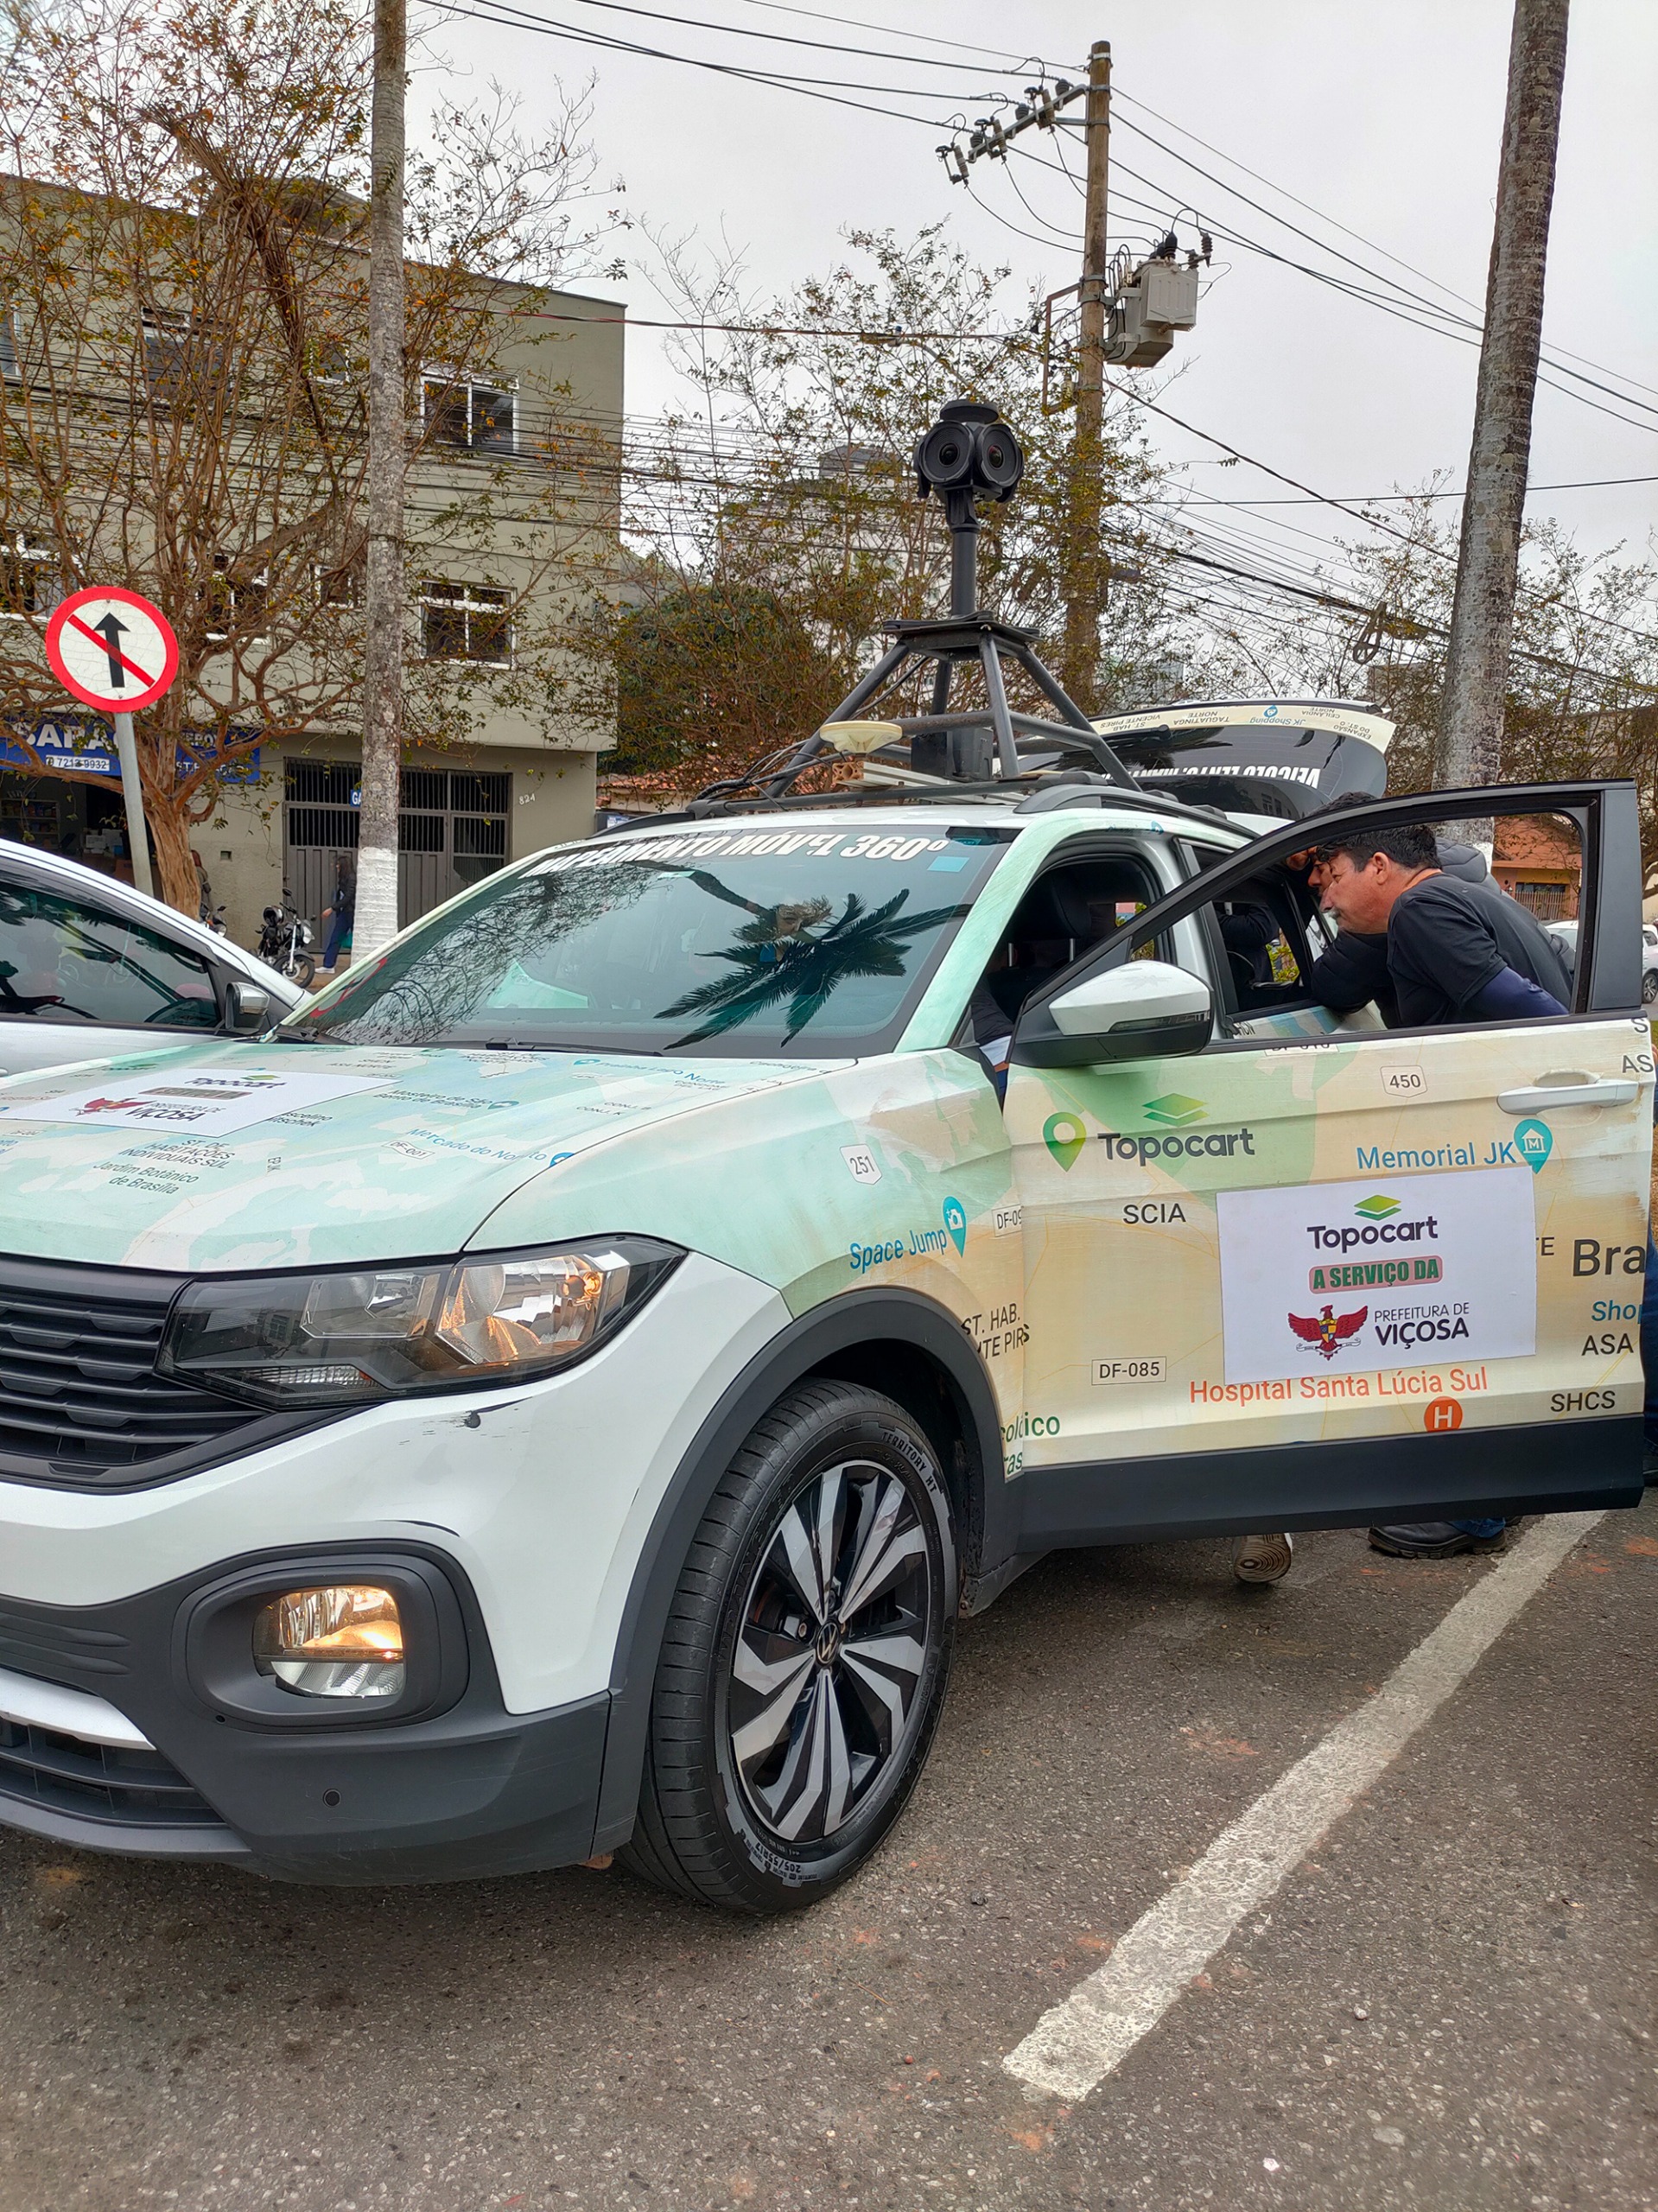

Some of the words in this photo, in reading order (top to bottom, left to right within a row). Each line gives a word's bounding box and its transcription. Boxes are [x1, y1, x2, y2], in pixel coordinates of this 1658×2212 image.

[1100, 719, 1123, 728] PIRES
[1126, 714, 1161, 724] VICENTE
[1172, 716, 1230, 725] TAGUATINGA
[1249, 716, 1293, 726] Shopping
[1333, 724, 1372, 741] EXPANSÃO
[518, 793, 536, 805] 824
[1622, 1054, 1654, 1074] AS
[1389, 1074, 1421, 1089] 450
[124, 1107, 206, 1122] VIÇOSA
[144, 1143, 236, 1160] HABITAÇÕES
[390, 1141, 427, 1158] DF-001
[408, 1128, 471, 1151] Mercado
[470, 1145, 492, 1155] do
[1097, 1128, 1255, 1166] Topocart
[118, 1148, 202, 1166] INDIVIDUAIS
[200, 1159, 231, 1169] SUL
[849, 1154, 876, 1176] 251
[1356, 1143, 1475, 1169] Memorial
[1483, 1141, 1516, 1164] JK
[93, 1160, 141, 1175] Jardim
[138, 1166, 200, 1184] Botânico
[109, 1175, 129, 1185] de
[1122, 1203, 1186, 1224] SCIA
[1306, 1215, 1439, 1254] Topocart
[849, 1236, 905, 1274] Space
[907, 1226, 948, 1258] Jump
[1572, 1238, 1646, 1276] Bra
[1312, 1268, 1327, 1289] A
[1330, 1260, 1410, 1287] SERVIÇO
[1413, 1258, 1439, 1280] DA
[990, 1302, 1020, 1332] HAB.
[1374, 1305, 1450, 1323] PREFEITURA
[1452, 1302, 1470, 1316] DE
[1374, 1318, 1470, 1349] VIÇOSA
[1581, 1332, 1634, 1356] ASA
[1098, 1362, 1160, 1379] DF-085
[1190, 1377, 1292, 1407] Hospital
[1299, 1374, 1369, 1399] Santa
[1376, 1369, 1443, 1396] Lúcia
[1450, 1365, 1488, 1391] Sul
[1550, 1390, 1616, 1412] SHCS
[882, 1432, 927, 1471] TERRITORY
[925, 1476, 937, 1493] HT
